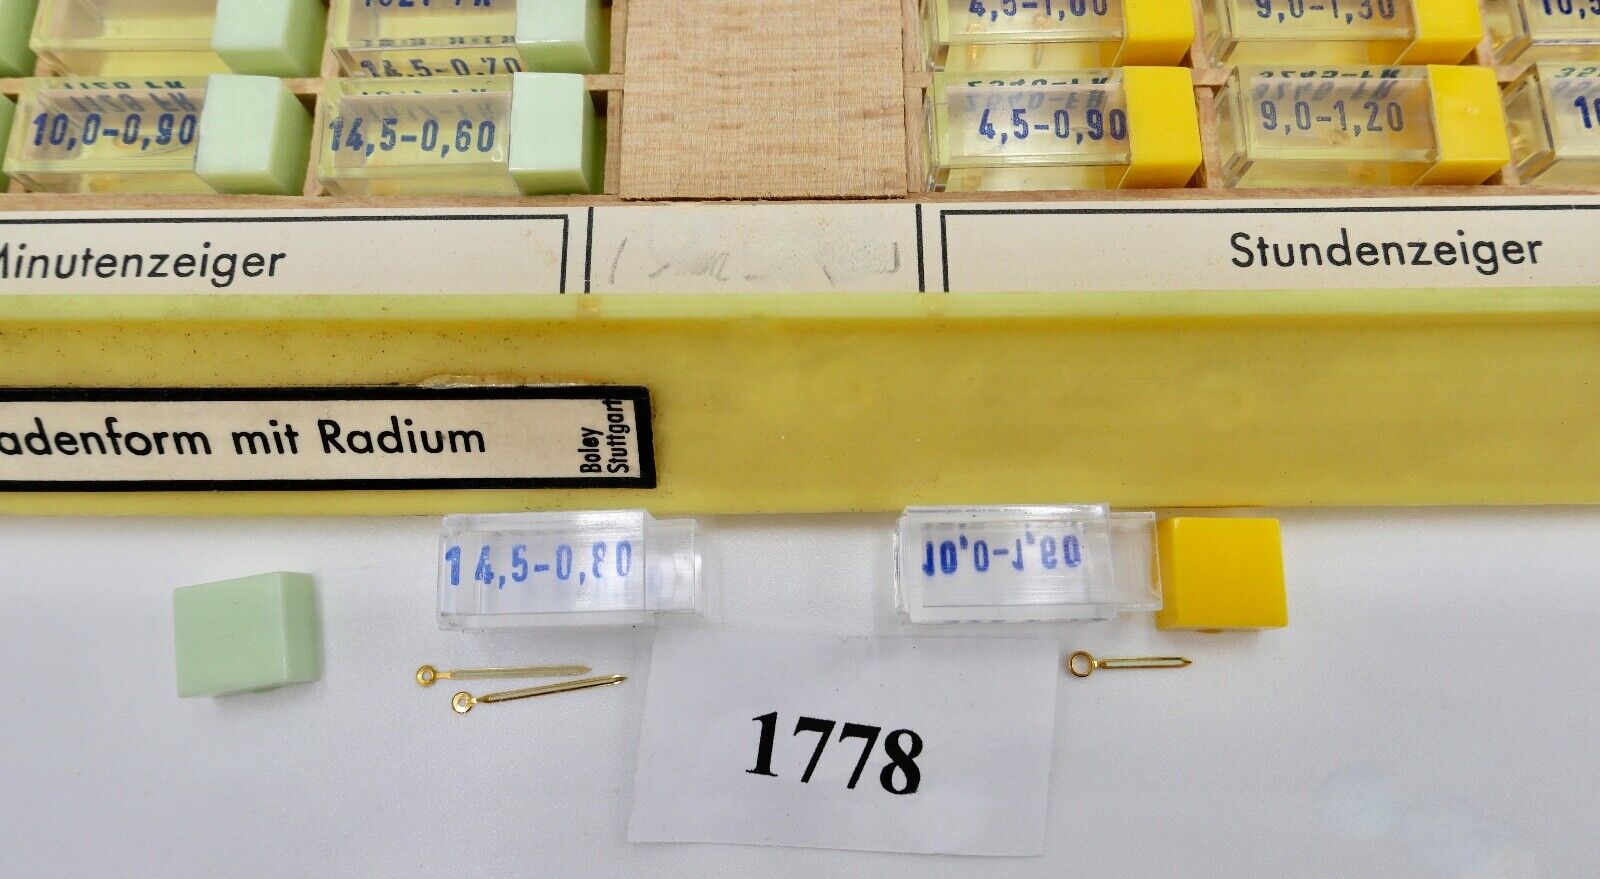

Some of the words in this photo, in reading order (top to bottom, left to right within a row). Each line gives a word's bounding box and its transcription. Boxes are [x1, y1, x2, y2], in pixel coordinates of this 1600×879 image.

[329, 117, 496, 158] 14,5-0,60
[979, 108, 1127, 144] 4,5-0,90
[1260, 100, 1404, 137] 9,0-1,20
[1230, 227, 1543, 275] Stundenzeiger
[231, 419, 299, 454] mit
[317, 415, 486, 454] Radium
[577, 426, 604, 473] Boley
[602, 398, 630, 473] Stuttgart
[445, 540, 633, 591] 14,5-0,80
[745, 711, 924, 795] 1778
